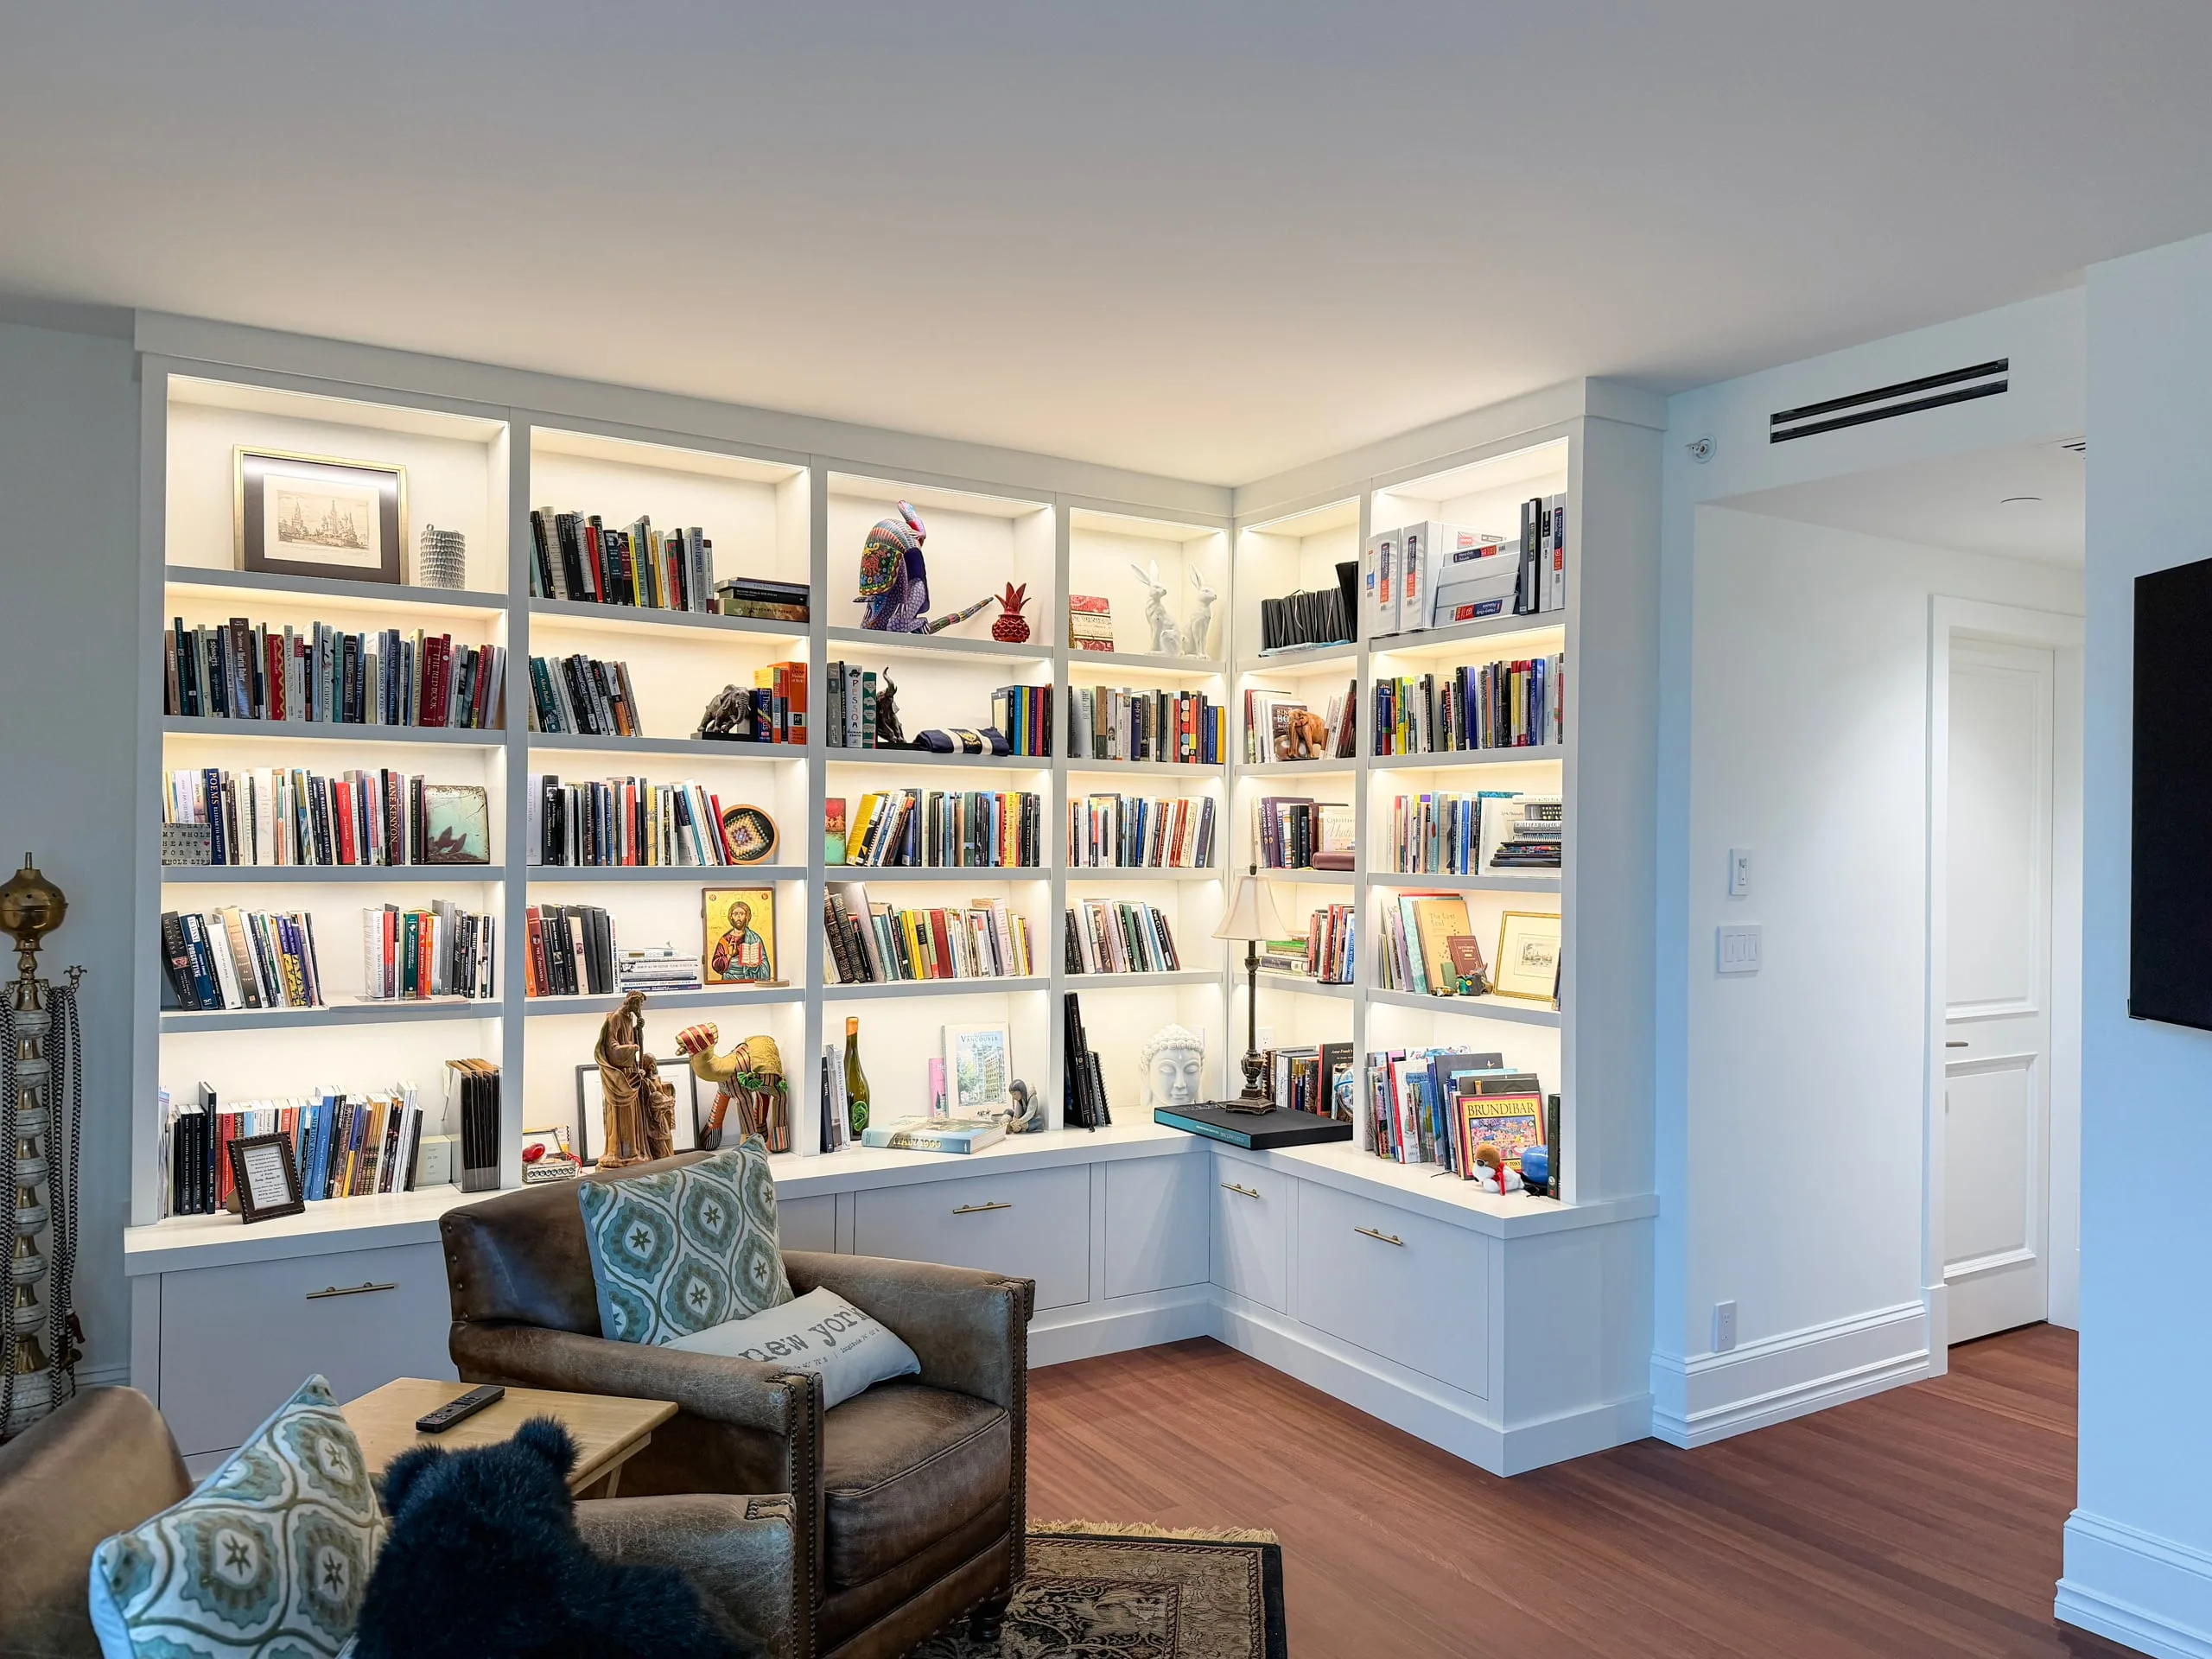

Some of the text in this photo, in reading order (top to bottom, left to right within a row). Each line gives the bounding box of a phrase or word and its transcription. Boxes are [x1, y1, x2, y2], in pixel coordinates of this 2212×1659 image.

[762, 696, 771, 731] Thesaurus
[209, 772, 219, 804] POEMS
[389, 804, 397, 843] KENYON
[164, 918, 176, 955] WITNESS
[173, 919, 184, 950] POETRY
[188, 943, 200, 978] FORGETTING
[338, 1100, 346, 1128] december
[1467, 1102, 1535, 1116] BRUNDIBAR
[310, 1117, 319, 1143] MERTON
[893, 1137, 918, 1147] ITALY
[738, 1333, 810, 1363] new
[807, 1305, 873, 1348] york
